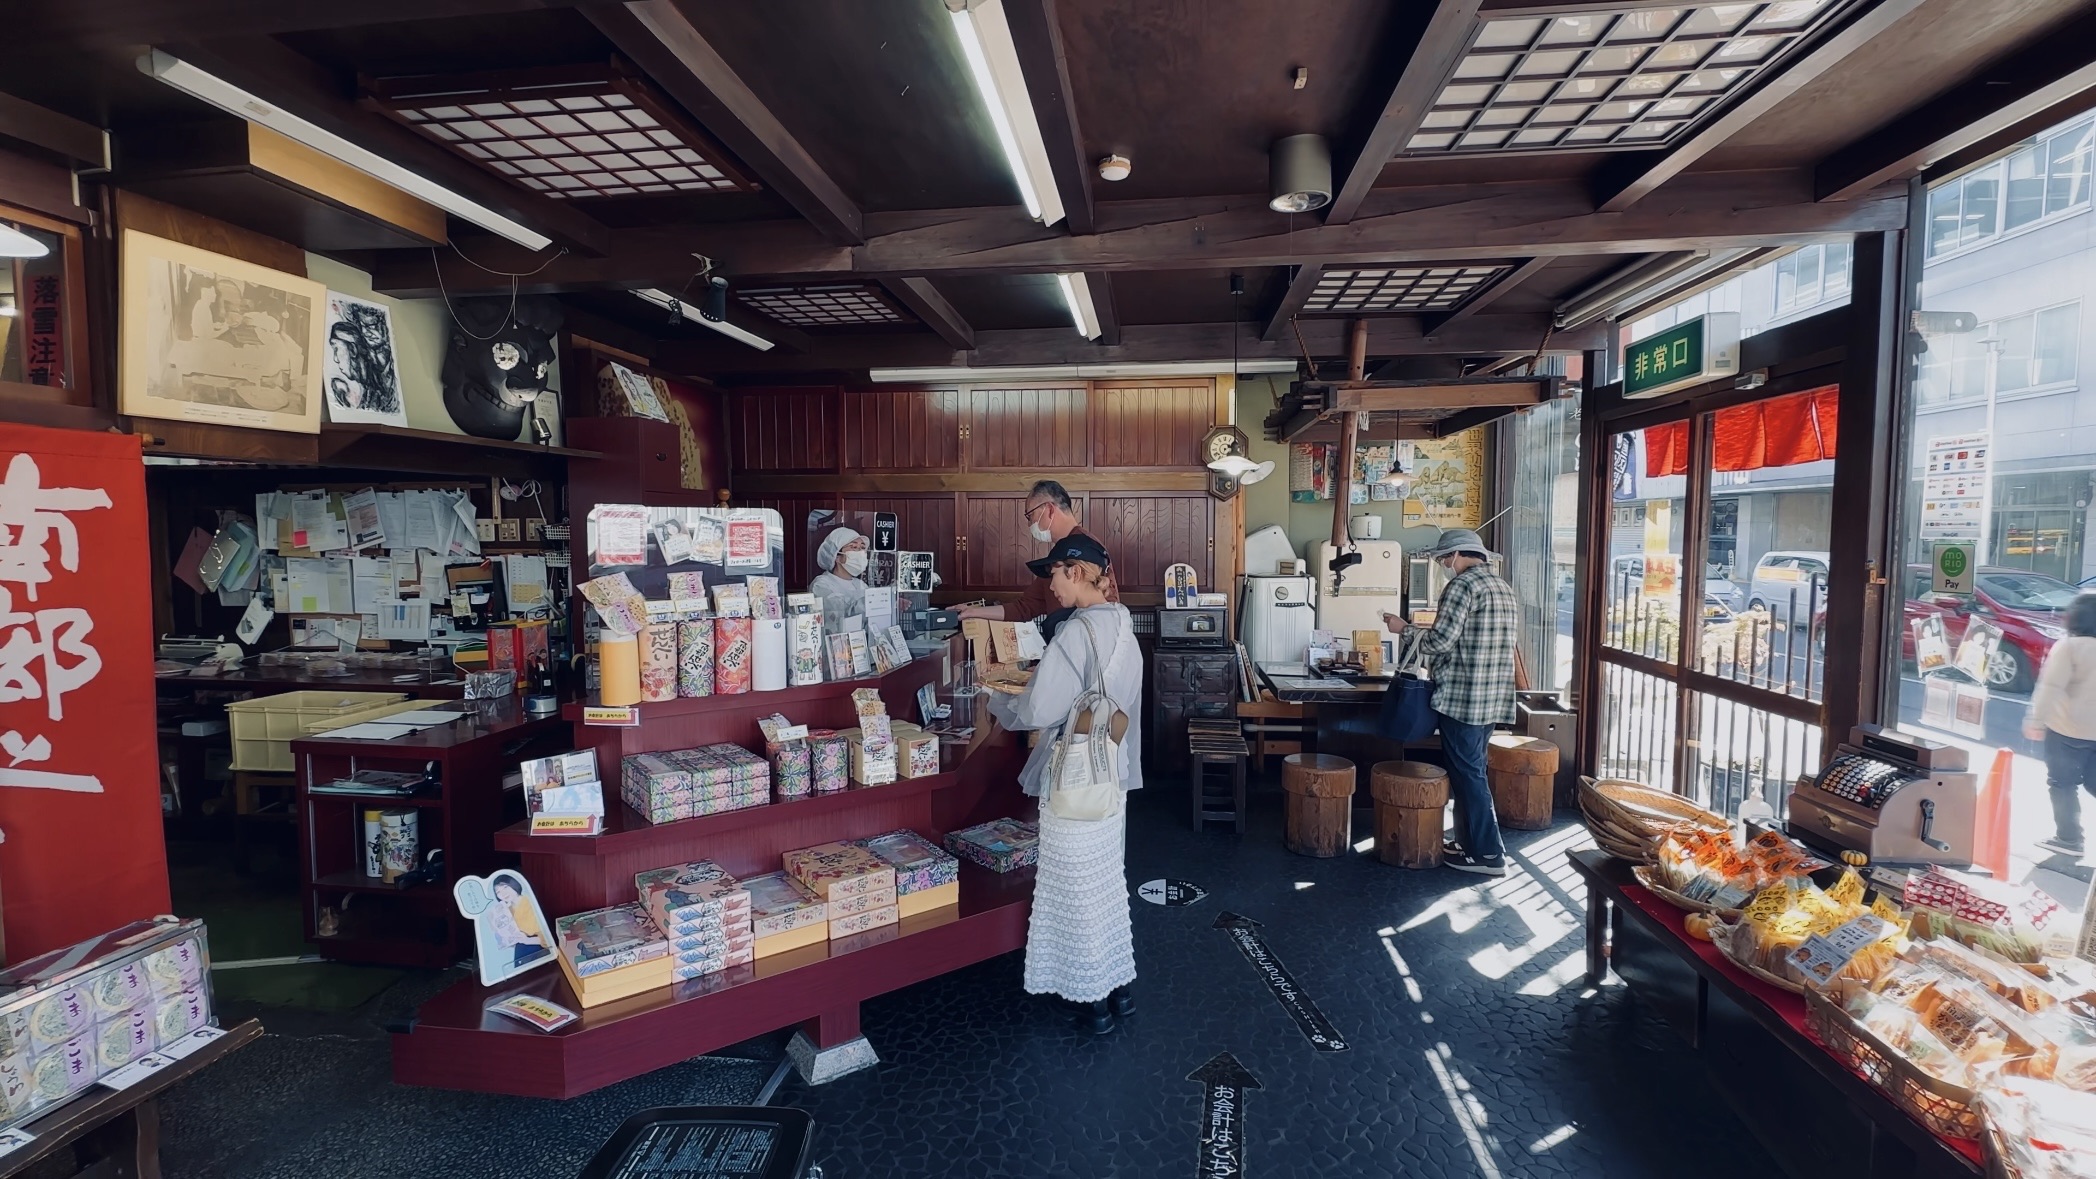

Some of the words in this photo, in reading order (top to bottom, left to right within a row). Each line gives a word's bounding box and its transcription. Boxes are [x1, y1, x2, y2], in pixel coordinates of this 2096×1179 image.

[1635, 337, 1688, 380] 非常口
[877, 520, 895, 528] CASHIER
[903, 561, 930, 569] CASHIER
[1945, 579, 1960, 590] Pay
[133, 1012, 145, 1044] ごま
[69, 1039, 84, 1074] ごま
[1210, 1085, 1237, 1179] お会計はこち
